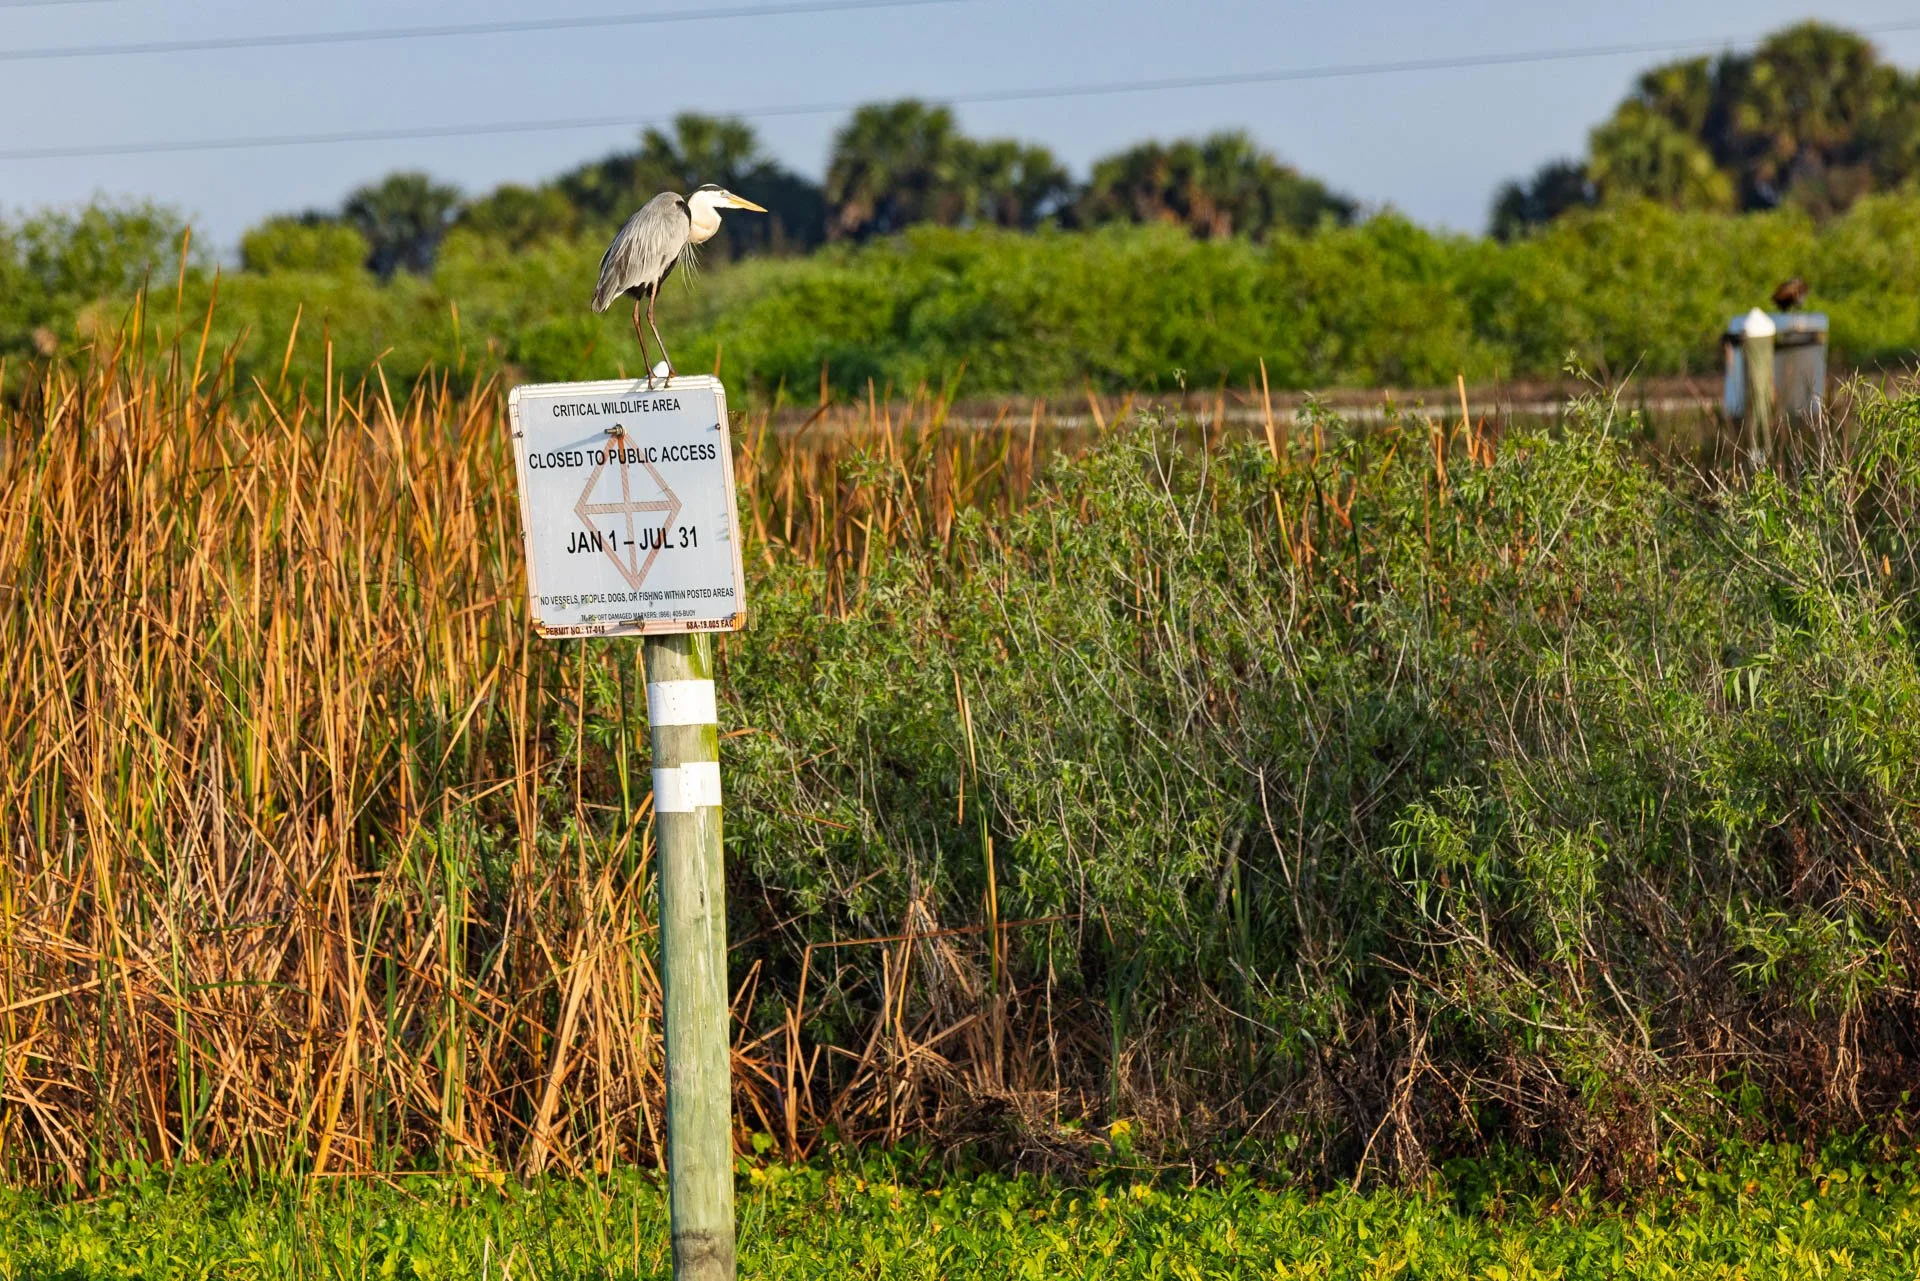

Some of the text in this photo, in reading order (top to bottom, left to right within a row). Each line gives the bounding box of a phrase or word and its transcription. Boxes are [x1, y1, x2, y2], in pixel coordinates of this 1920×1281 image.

[553, 398, 681, 417] CRITICAL WILDLIFE AREA
[529, 443, 716, 469] CLOSED TO PUBLIC ACCESS
[567, 531, 603, 554] JAN
[608, 530, 617, 551] 1
[639, 527, 674, 550] JUL
[678, 526, 698, 548] 31
[540, 596, 550, 606] NO
[608, 592, 628, 603] DOGS,
[628, 591, 638, 602] OR
[639, 590, 663, 601] FISHING
[664, 589, 686, 600] WITHIN
[687, 588, 712, 599] POSTED
[713, 587, 734, 597] AREAS
[545, 626, 569, 636] PERMIT
